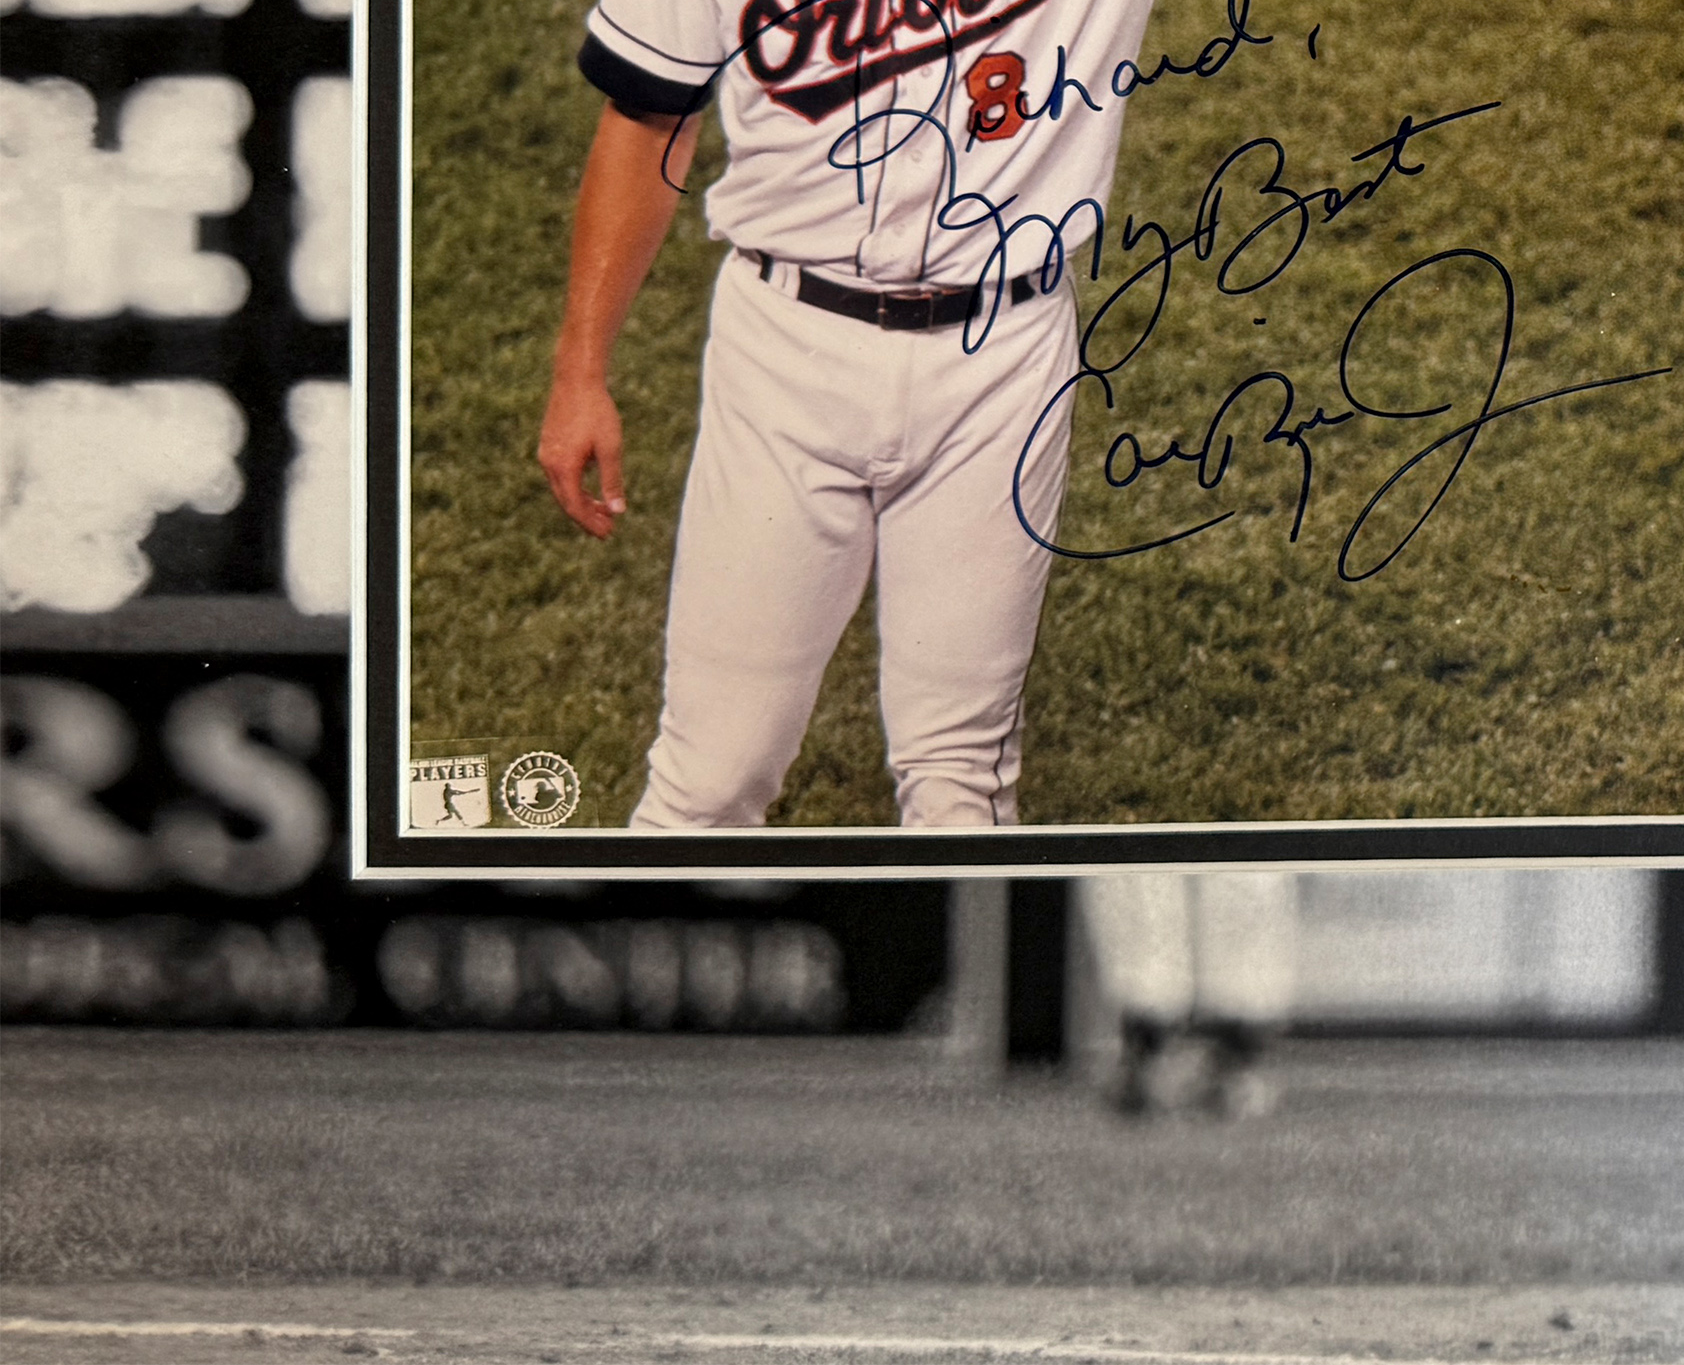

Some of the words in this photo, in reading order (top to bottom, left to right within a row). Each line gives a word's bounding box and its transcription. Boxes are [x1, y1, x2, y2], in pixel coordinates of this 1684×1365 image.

[962, 51, 1031, 143] 8
[1194, 100, 1502, 295] Best
[410, 763, 487, 782] PLAYERS
